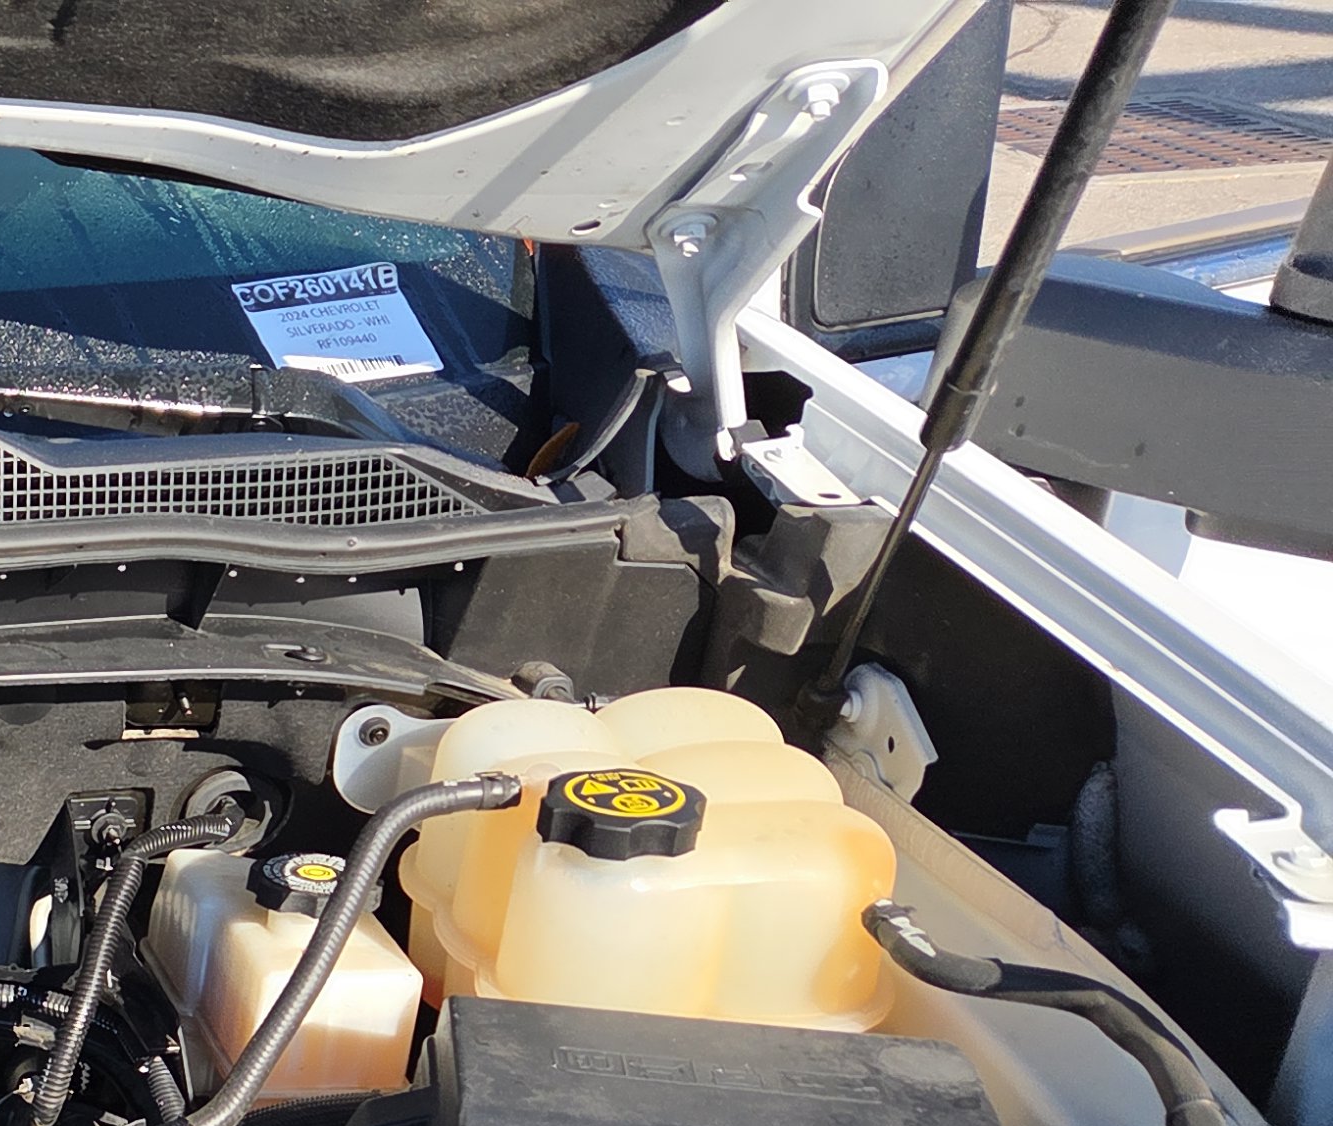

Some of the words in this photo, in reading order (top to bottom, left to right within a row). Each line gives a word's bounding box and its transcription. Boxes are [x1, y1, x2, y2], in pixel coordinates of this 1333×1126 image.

[278, 310, 309, 323] 2024
[310, 300, 380, 319] CHEVROLET
[286, 319, 355, 338] SILVERADO
[364, 314, 391, 327] WHI
[317, 332, 377, 350] RF109440
